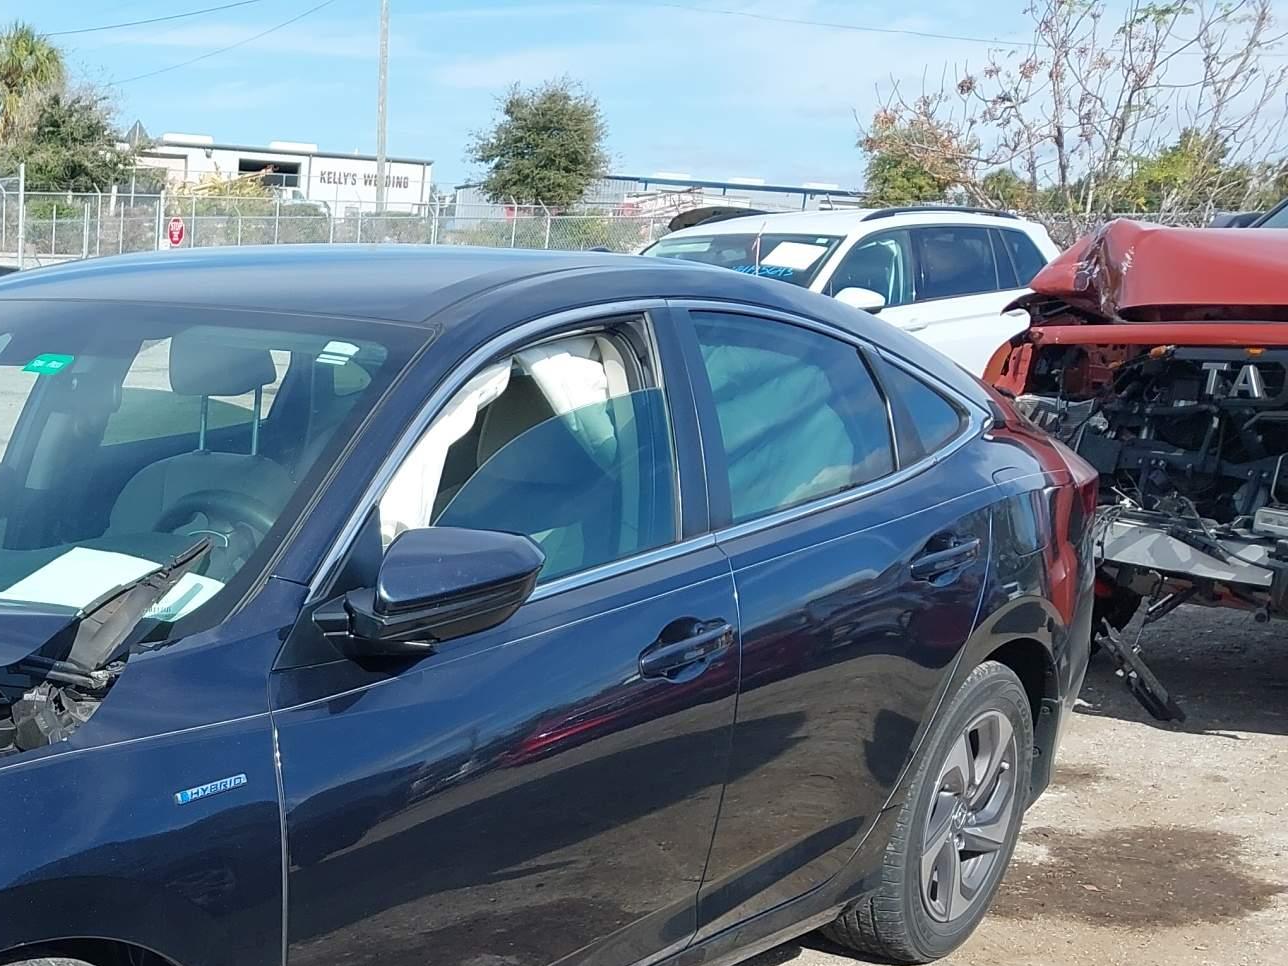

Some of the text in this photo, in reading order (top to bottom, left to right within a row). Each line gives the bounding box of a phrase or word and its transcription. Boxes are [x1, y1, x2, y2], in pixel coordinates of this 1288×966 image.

[319, 169, 409, 189] KELLY'S WEDING
[190, 776, 243, 800] HYBRID
